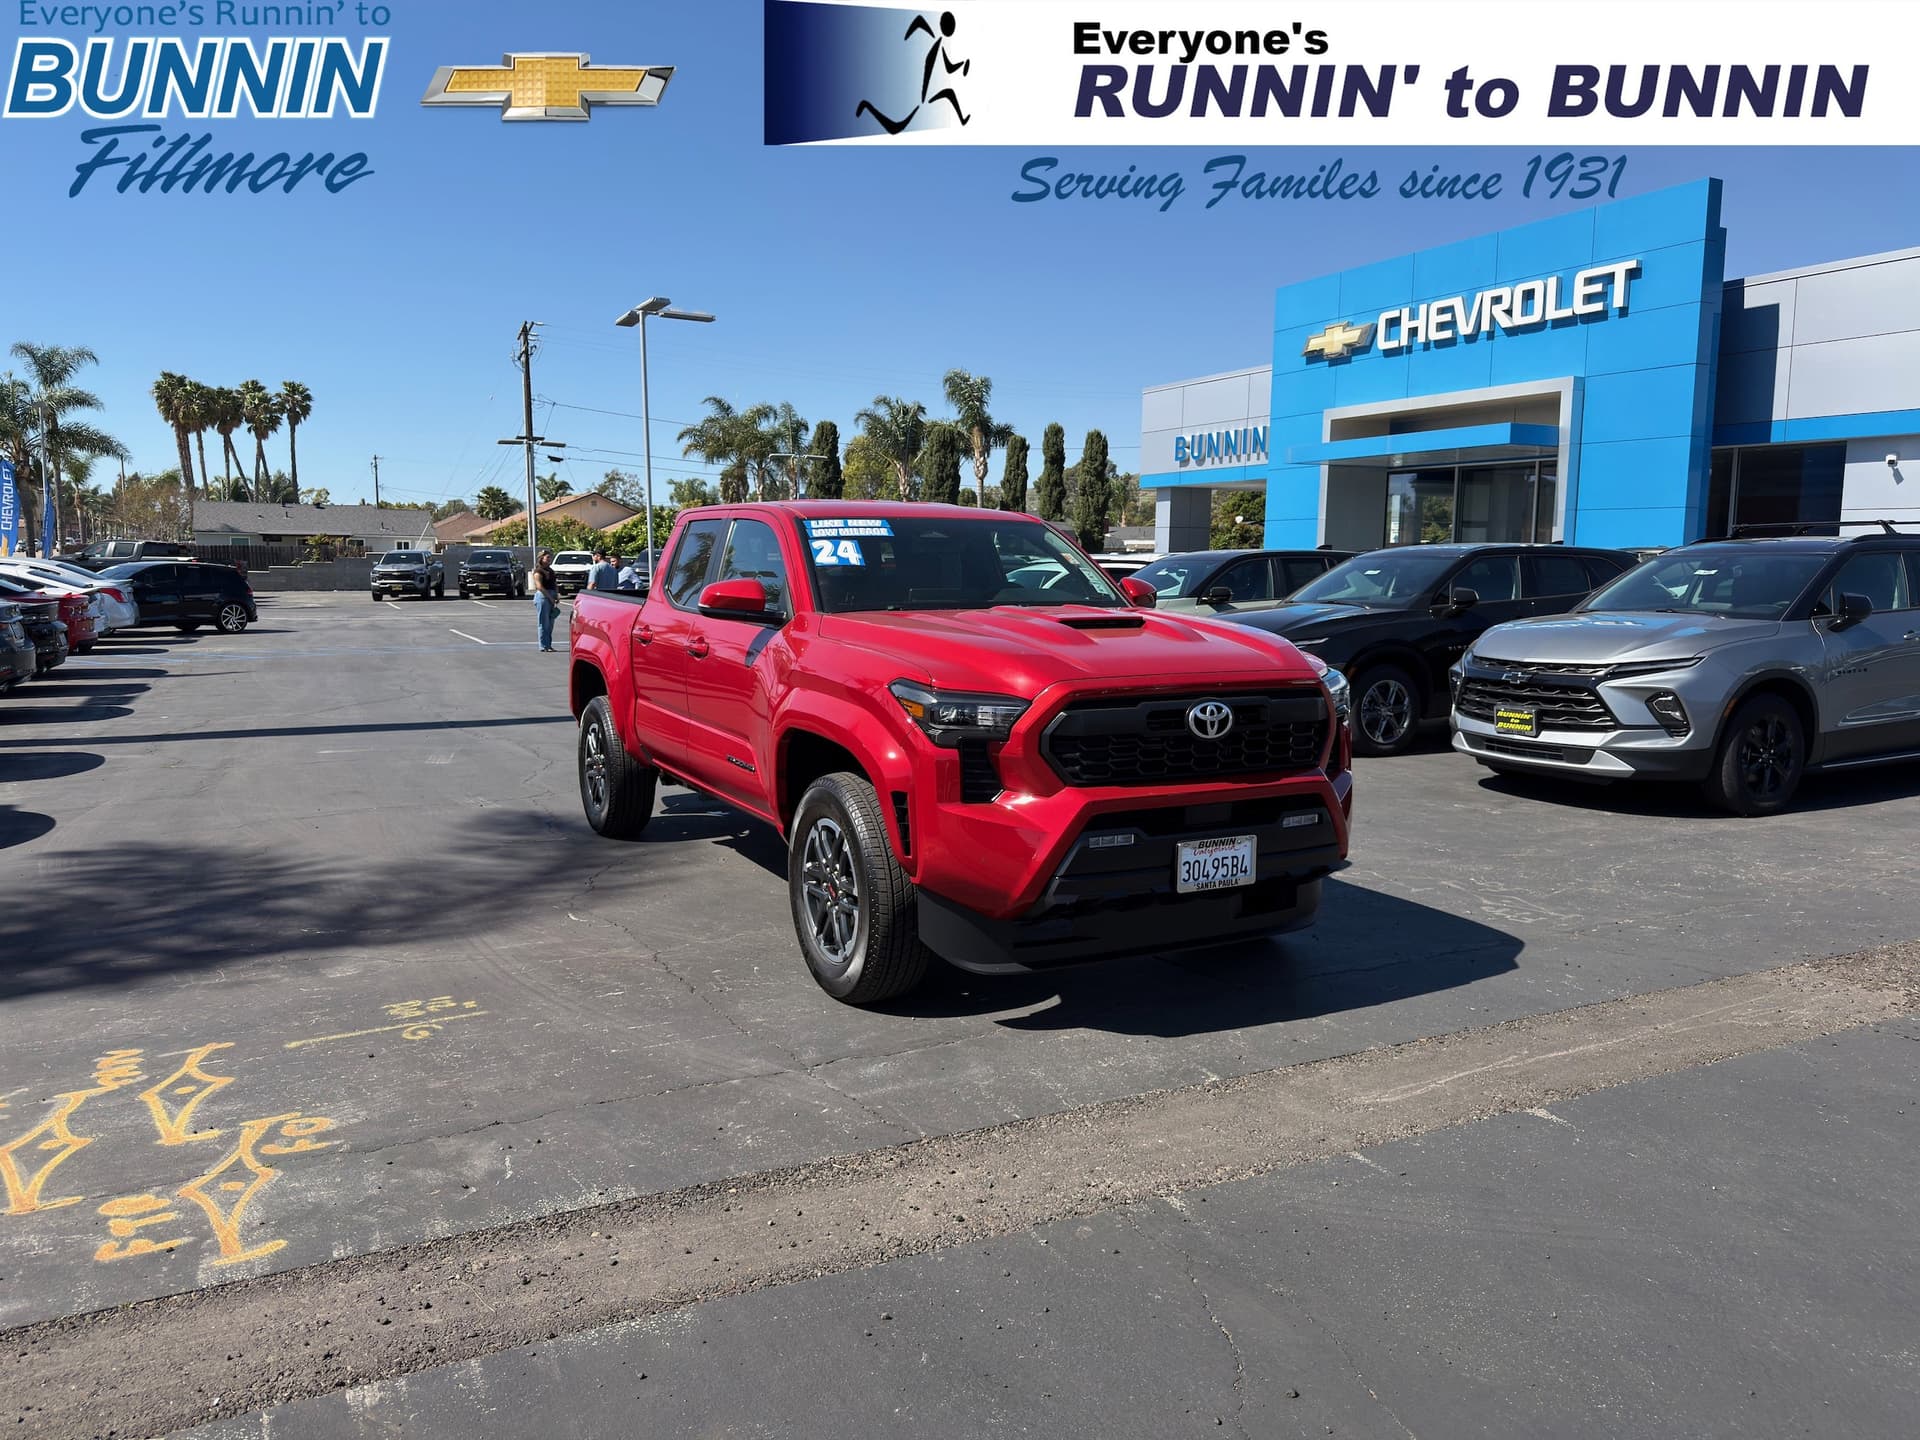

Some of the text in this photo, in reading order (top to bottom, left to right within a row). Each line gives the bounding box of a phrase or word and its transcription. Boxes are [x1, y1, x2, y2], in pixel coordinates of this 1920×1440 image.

[1377, 259, 1640, 352] CHEVROLET
[1174, 425, 1267, 462] BUNNIN
[1, 466, 14, 531] CHEVROLET
[812, 540, 861, 565] 24
[1199, 838, 1236, 848] BUNNIN
[1182, 854, 1248, 882] 30495B4
